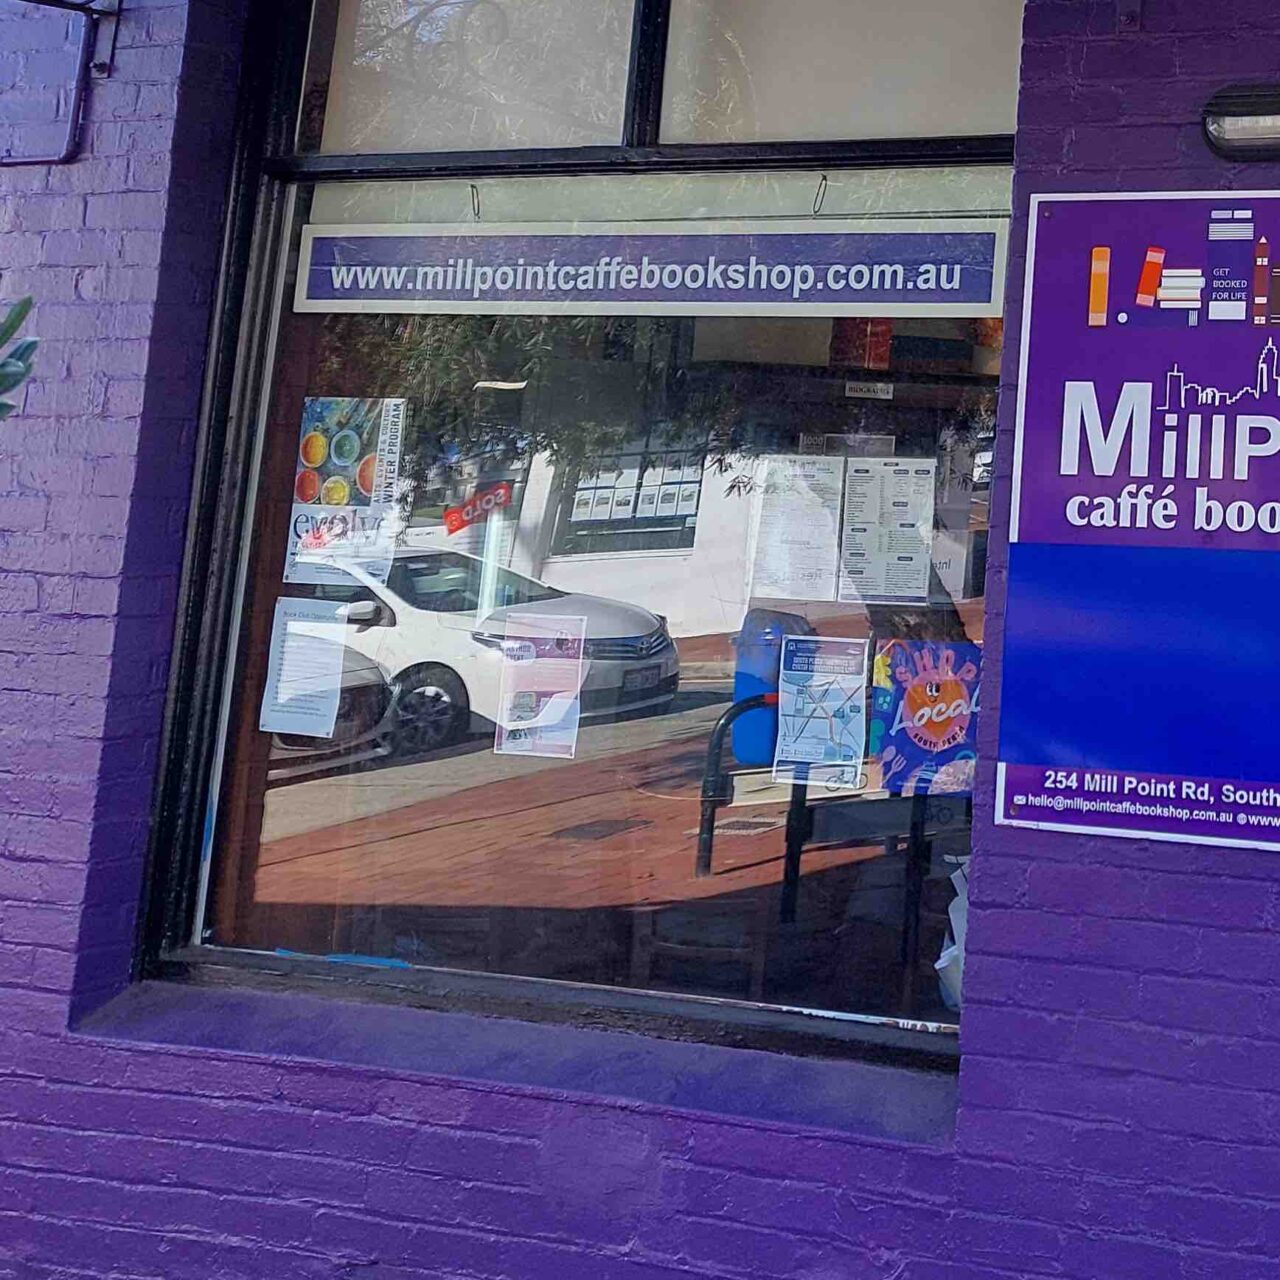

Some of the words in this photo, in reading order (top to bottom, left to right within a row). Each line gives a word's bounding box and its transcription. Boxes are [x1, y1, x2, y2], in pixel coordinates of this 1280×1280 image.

[330, 256, 961, 299] www.millpointcaffebookshop.com.au
[1212, 279, 1248, 288] BOOKED
[1213, 267, 1231, 277] GET
[1212, 291, 1230, 300] FOR
[1231, 292, 1248, 300] LIFE
[387, 403, 402, 455] PROGRAM
[382, 461, 396, 504] WINTER
[1065, 484, 1178, 529] caffé
[888, 682, 982, 737] Local
[1043, 770, 1079, 791] 254
[1084, 774, 1119, 795] Mill
[1125, 777, 1179, 800] Point
[1181, 782, 1215, 804] Rd,
[1027, 794, 1233, 825] hello@millpointcaffebookshop.com.au
